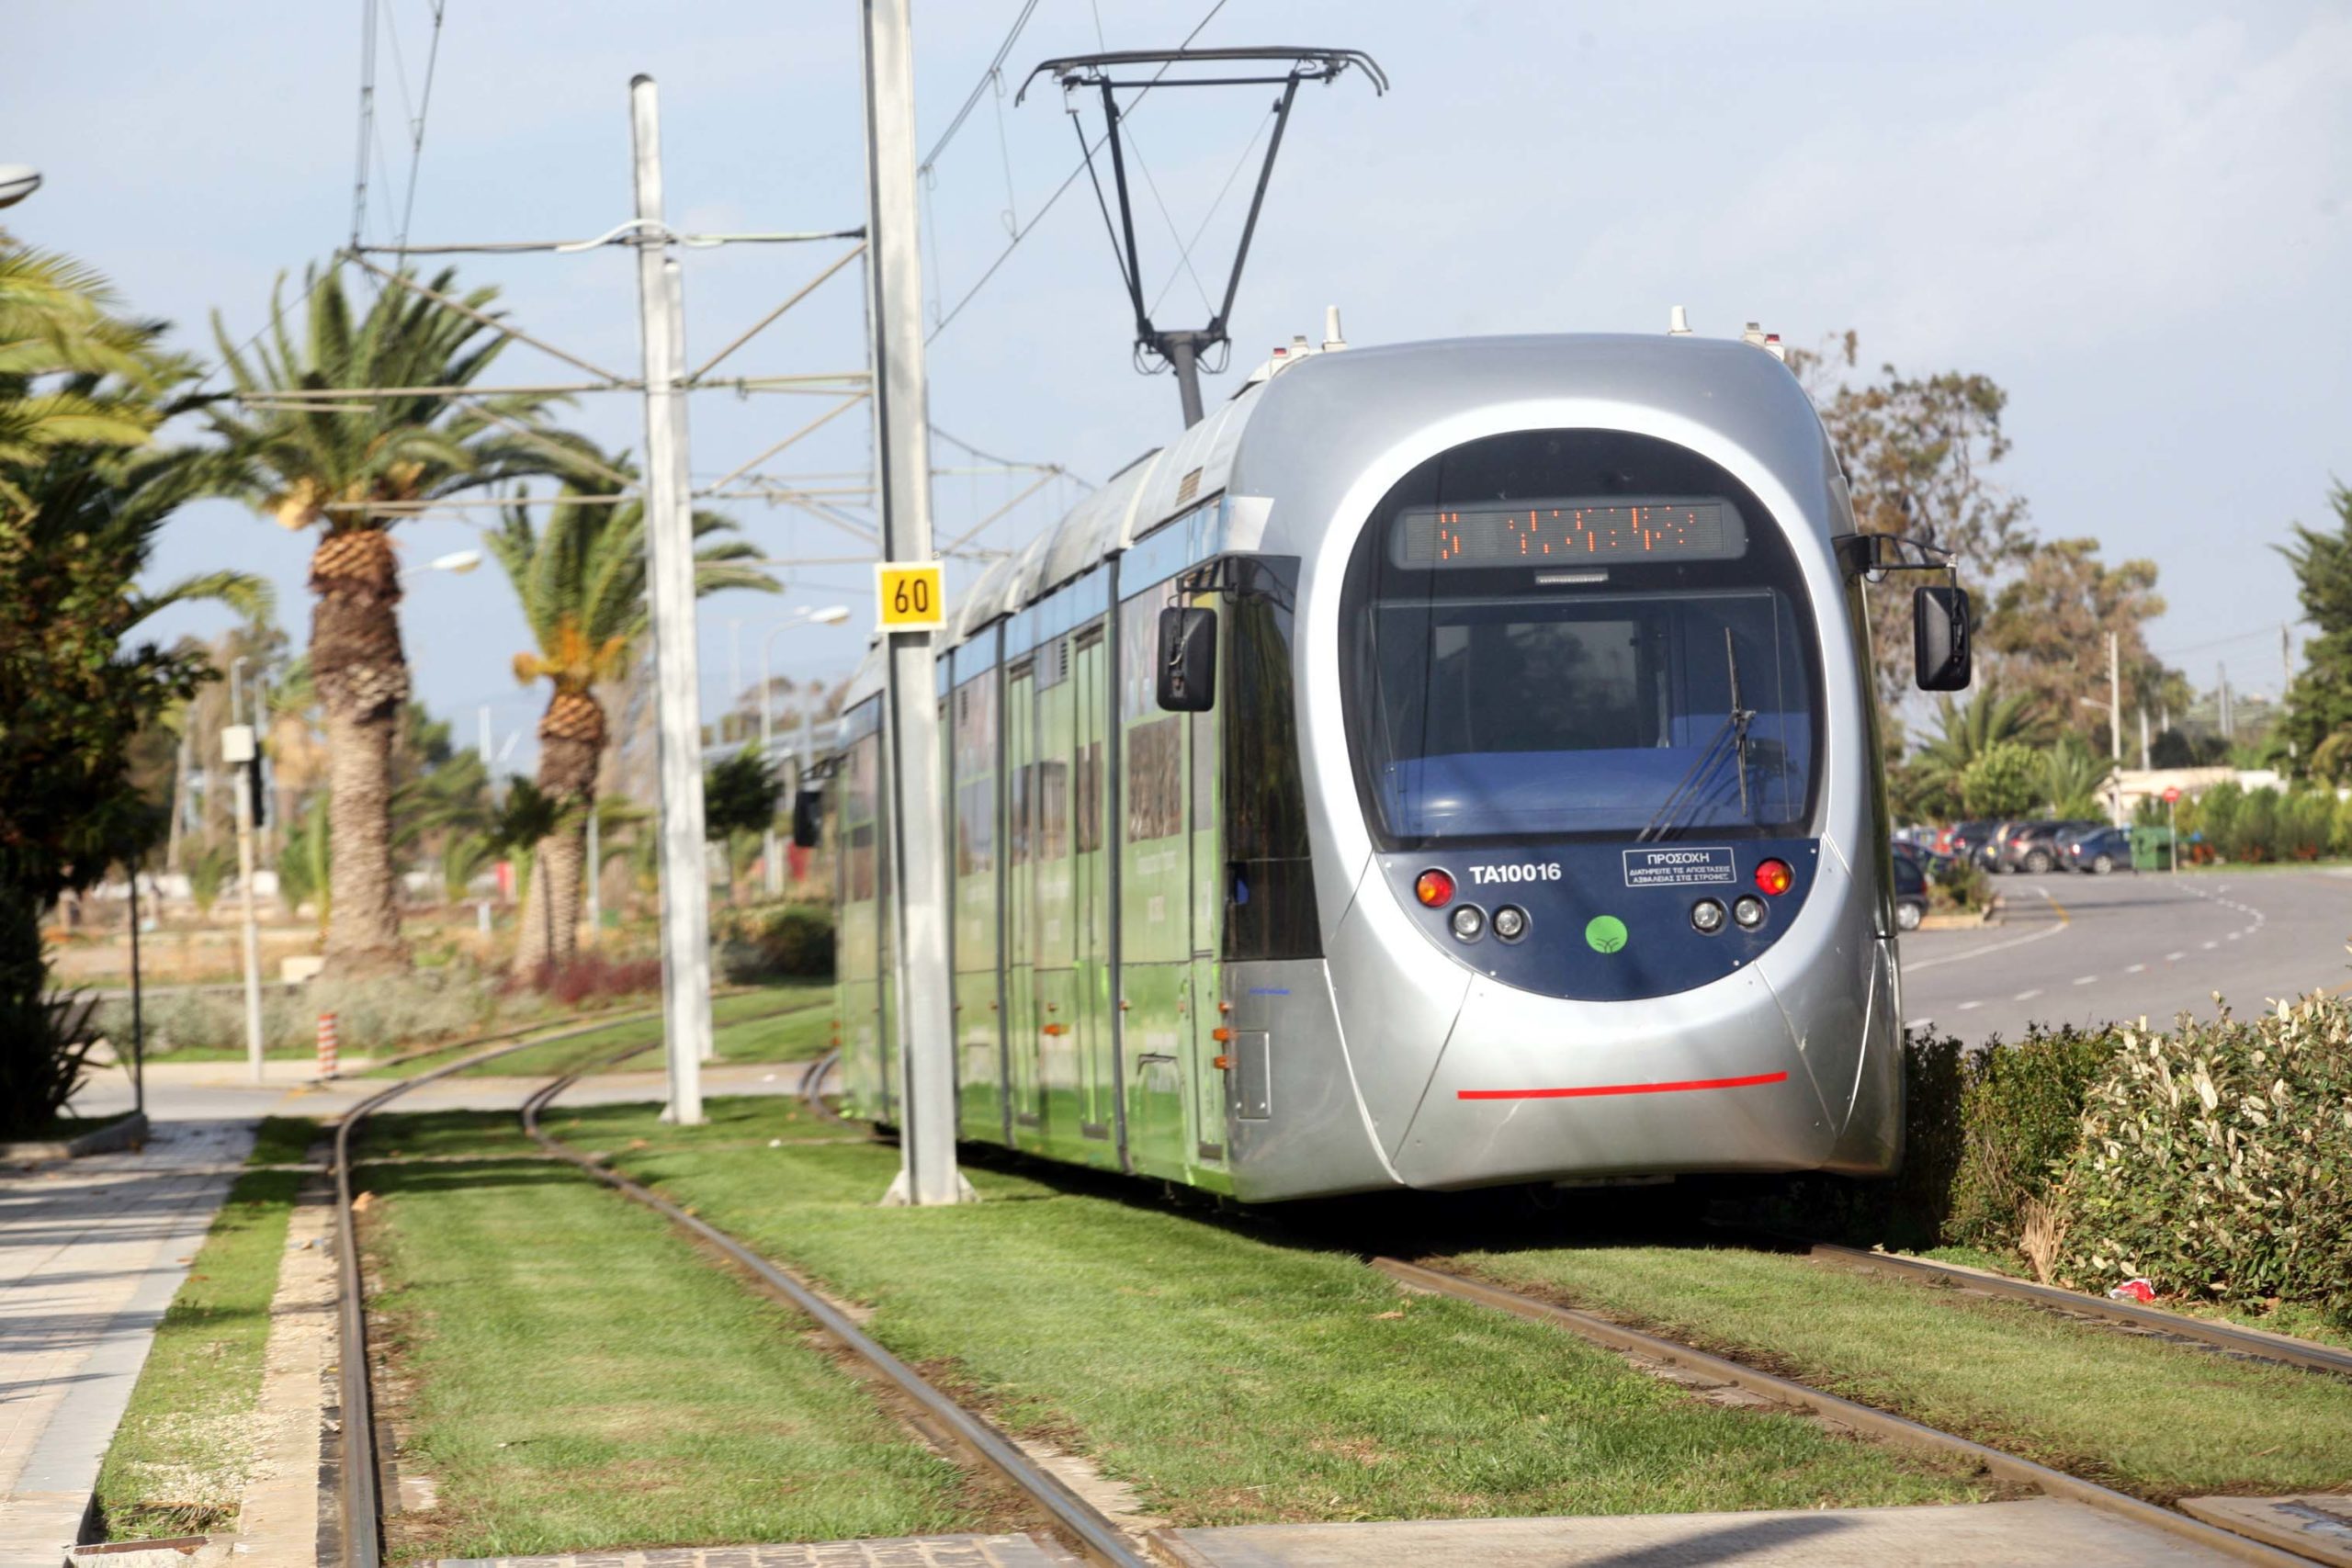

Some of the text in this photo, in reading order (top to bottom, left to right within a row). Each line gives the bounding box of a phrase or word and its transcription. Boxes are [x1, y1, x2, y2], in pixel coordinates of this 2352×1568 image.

[895, 579, 928, 614] 60
[1647, 852, 1710, 865] ΠΡΟΣΟΧΗ
[1469, 863, 1562, 885] TA10016
